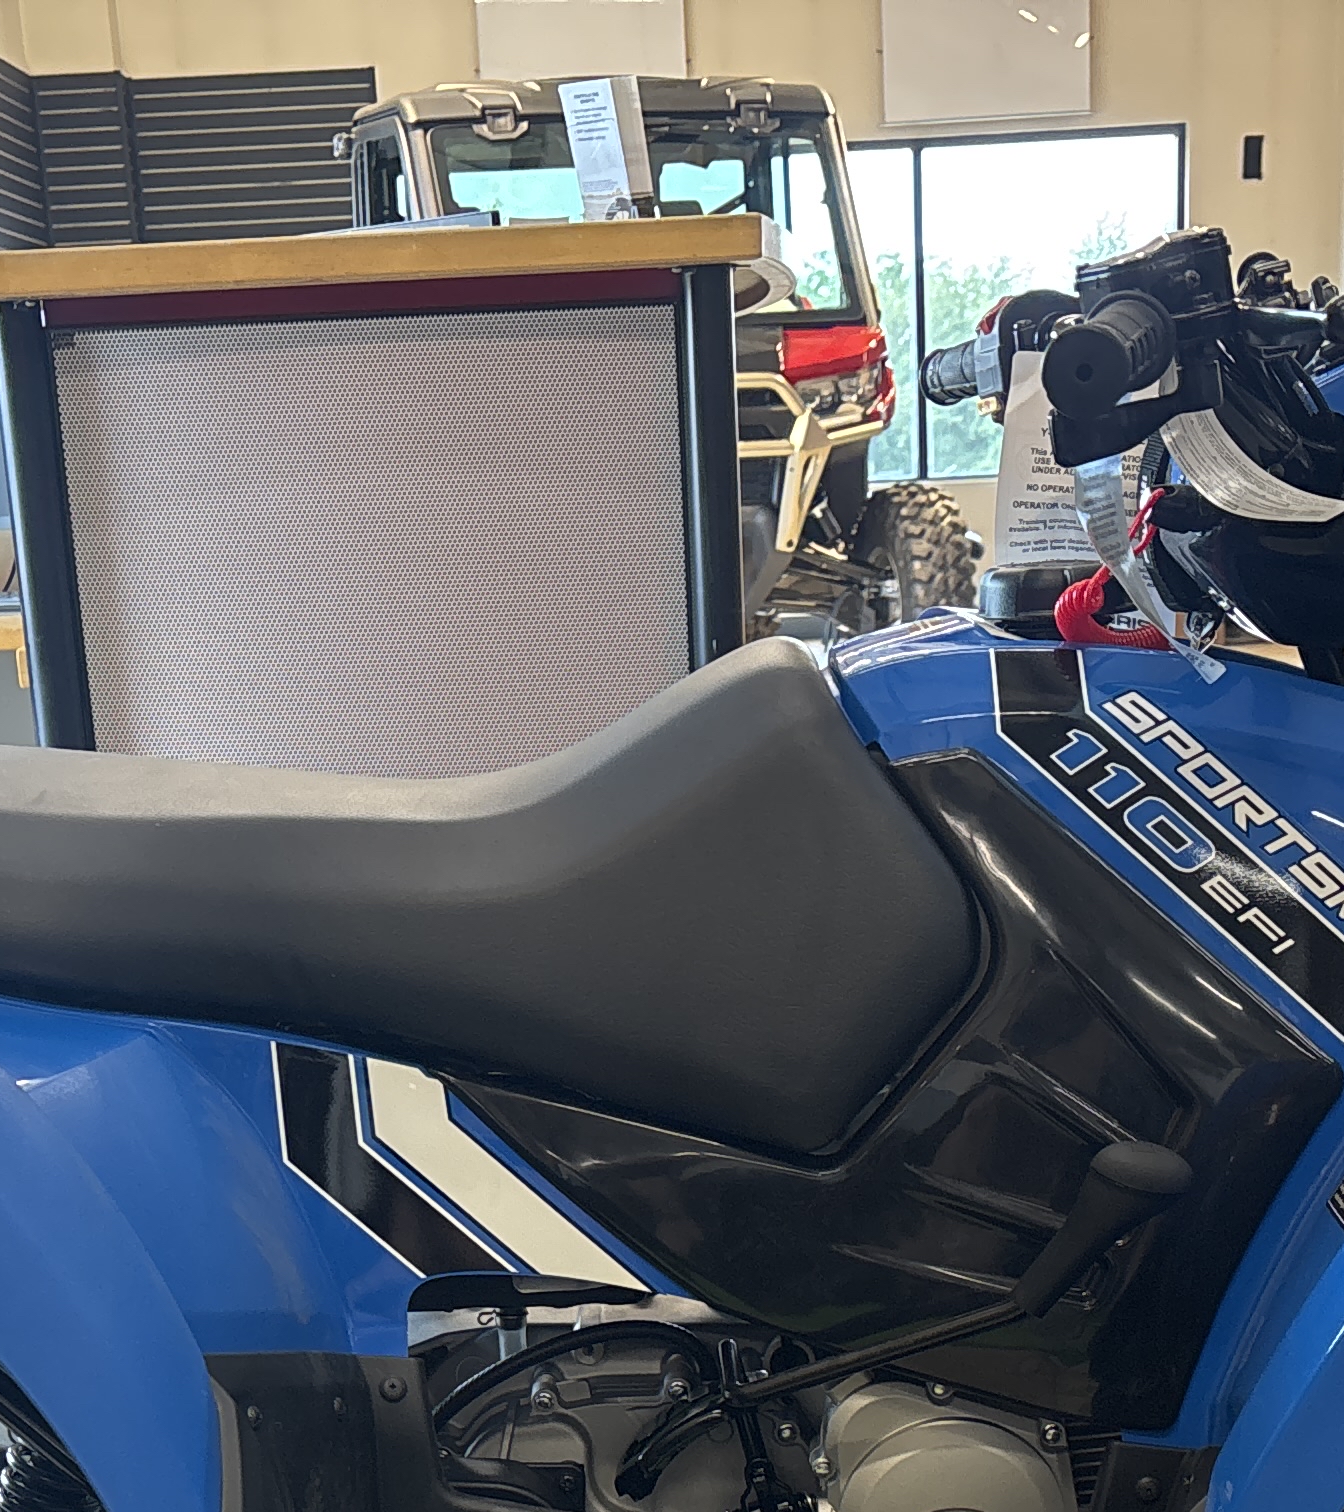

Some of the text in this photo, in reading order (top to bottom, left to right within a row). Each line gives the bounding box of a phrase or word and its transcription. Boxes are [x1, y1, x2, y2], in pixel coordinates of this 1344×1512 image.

[1034, 456, 1052, 465] USE
[1031, 466, 1062, 475] UNDER
[1026, 483, 1040, 492] NO
[1041, 484, 1076, 494] OPERAT
[1012, 500, 1060, 511] OPERATOR
[1049, 728, 1216, 874] 110
[1200, 874, 1296, 955] EFI
